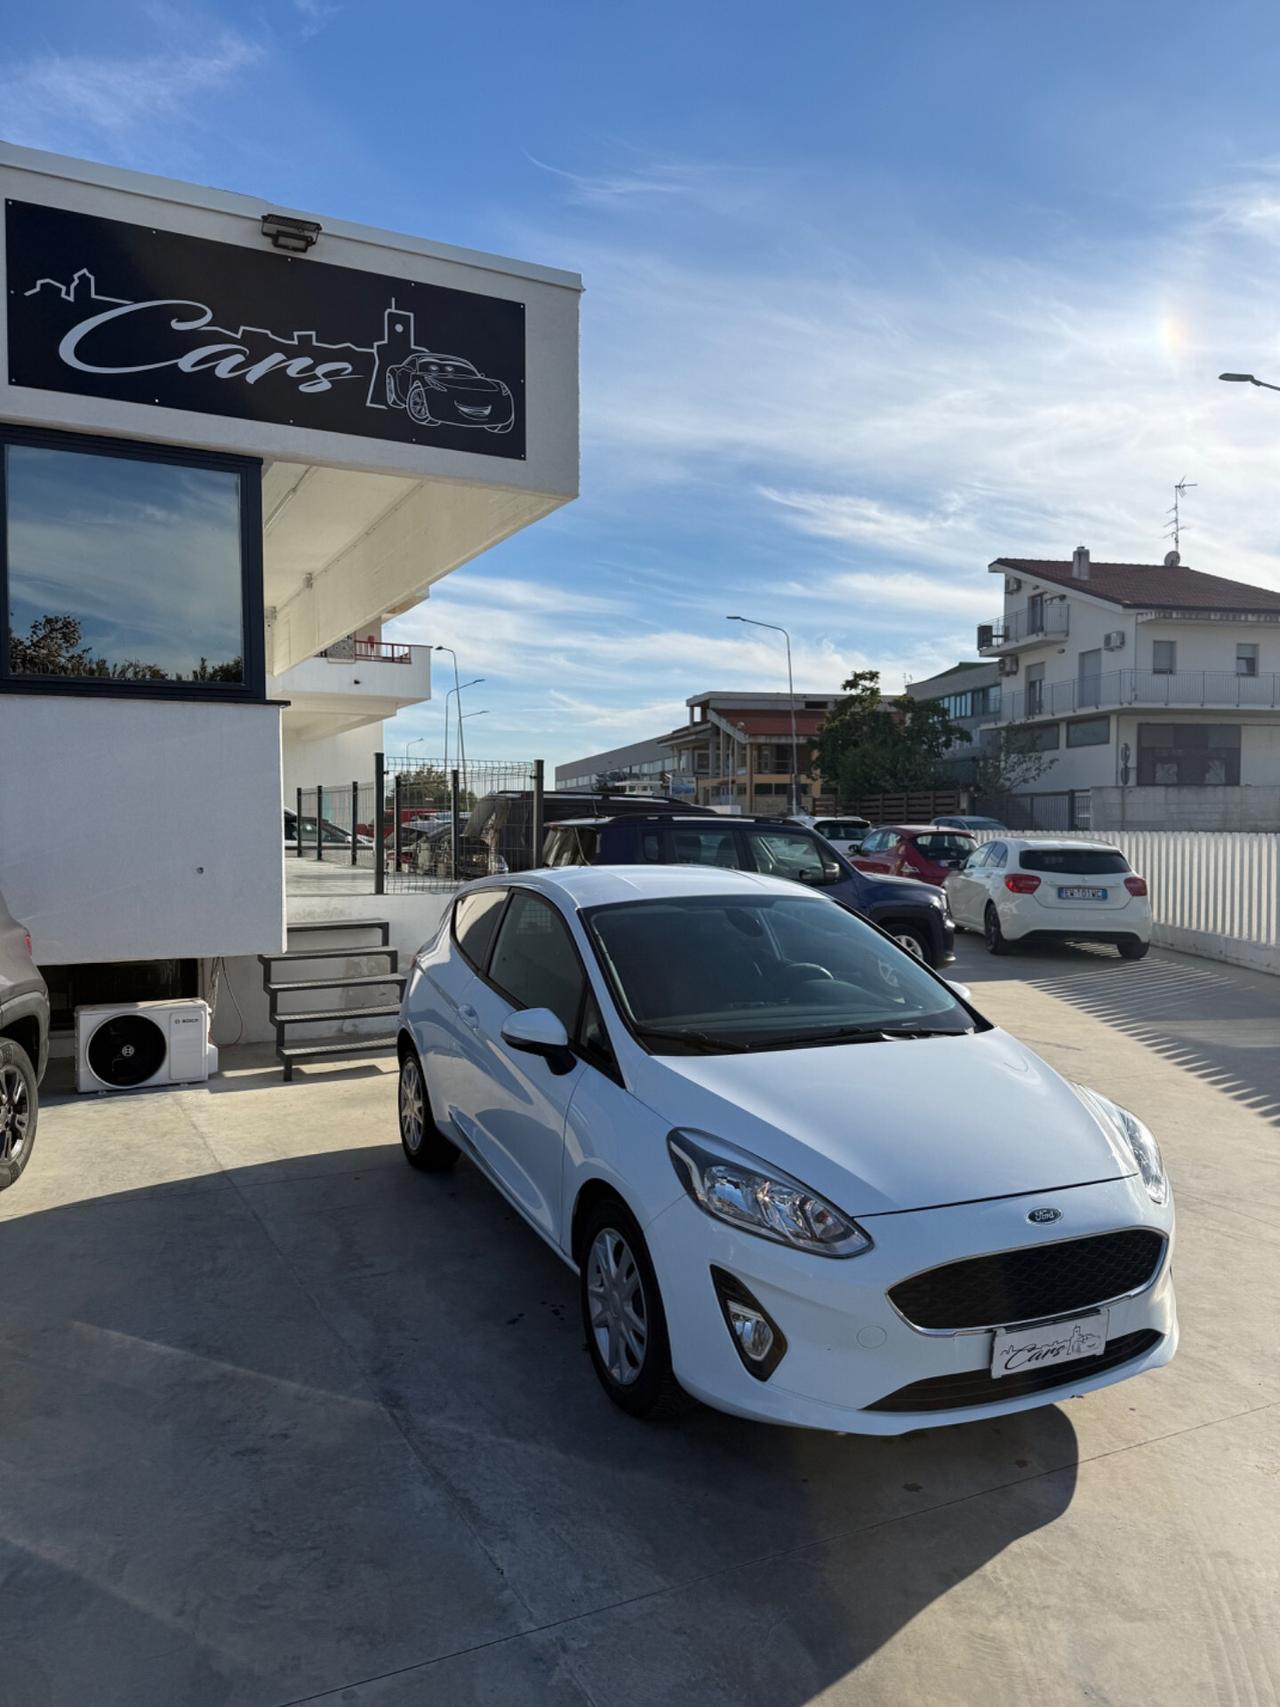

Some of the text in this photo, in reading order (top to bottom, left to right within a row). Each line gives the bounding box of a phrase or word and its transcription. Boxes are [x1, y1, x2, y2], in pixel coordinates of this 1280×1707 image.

[58, 299, 364, 394] Cars
[1034, 1209, 1055, 1221] Ford
[1004, 1343, 1066, 1370] Cars
